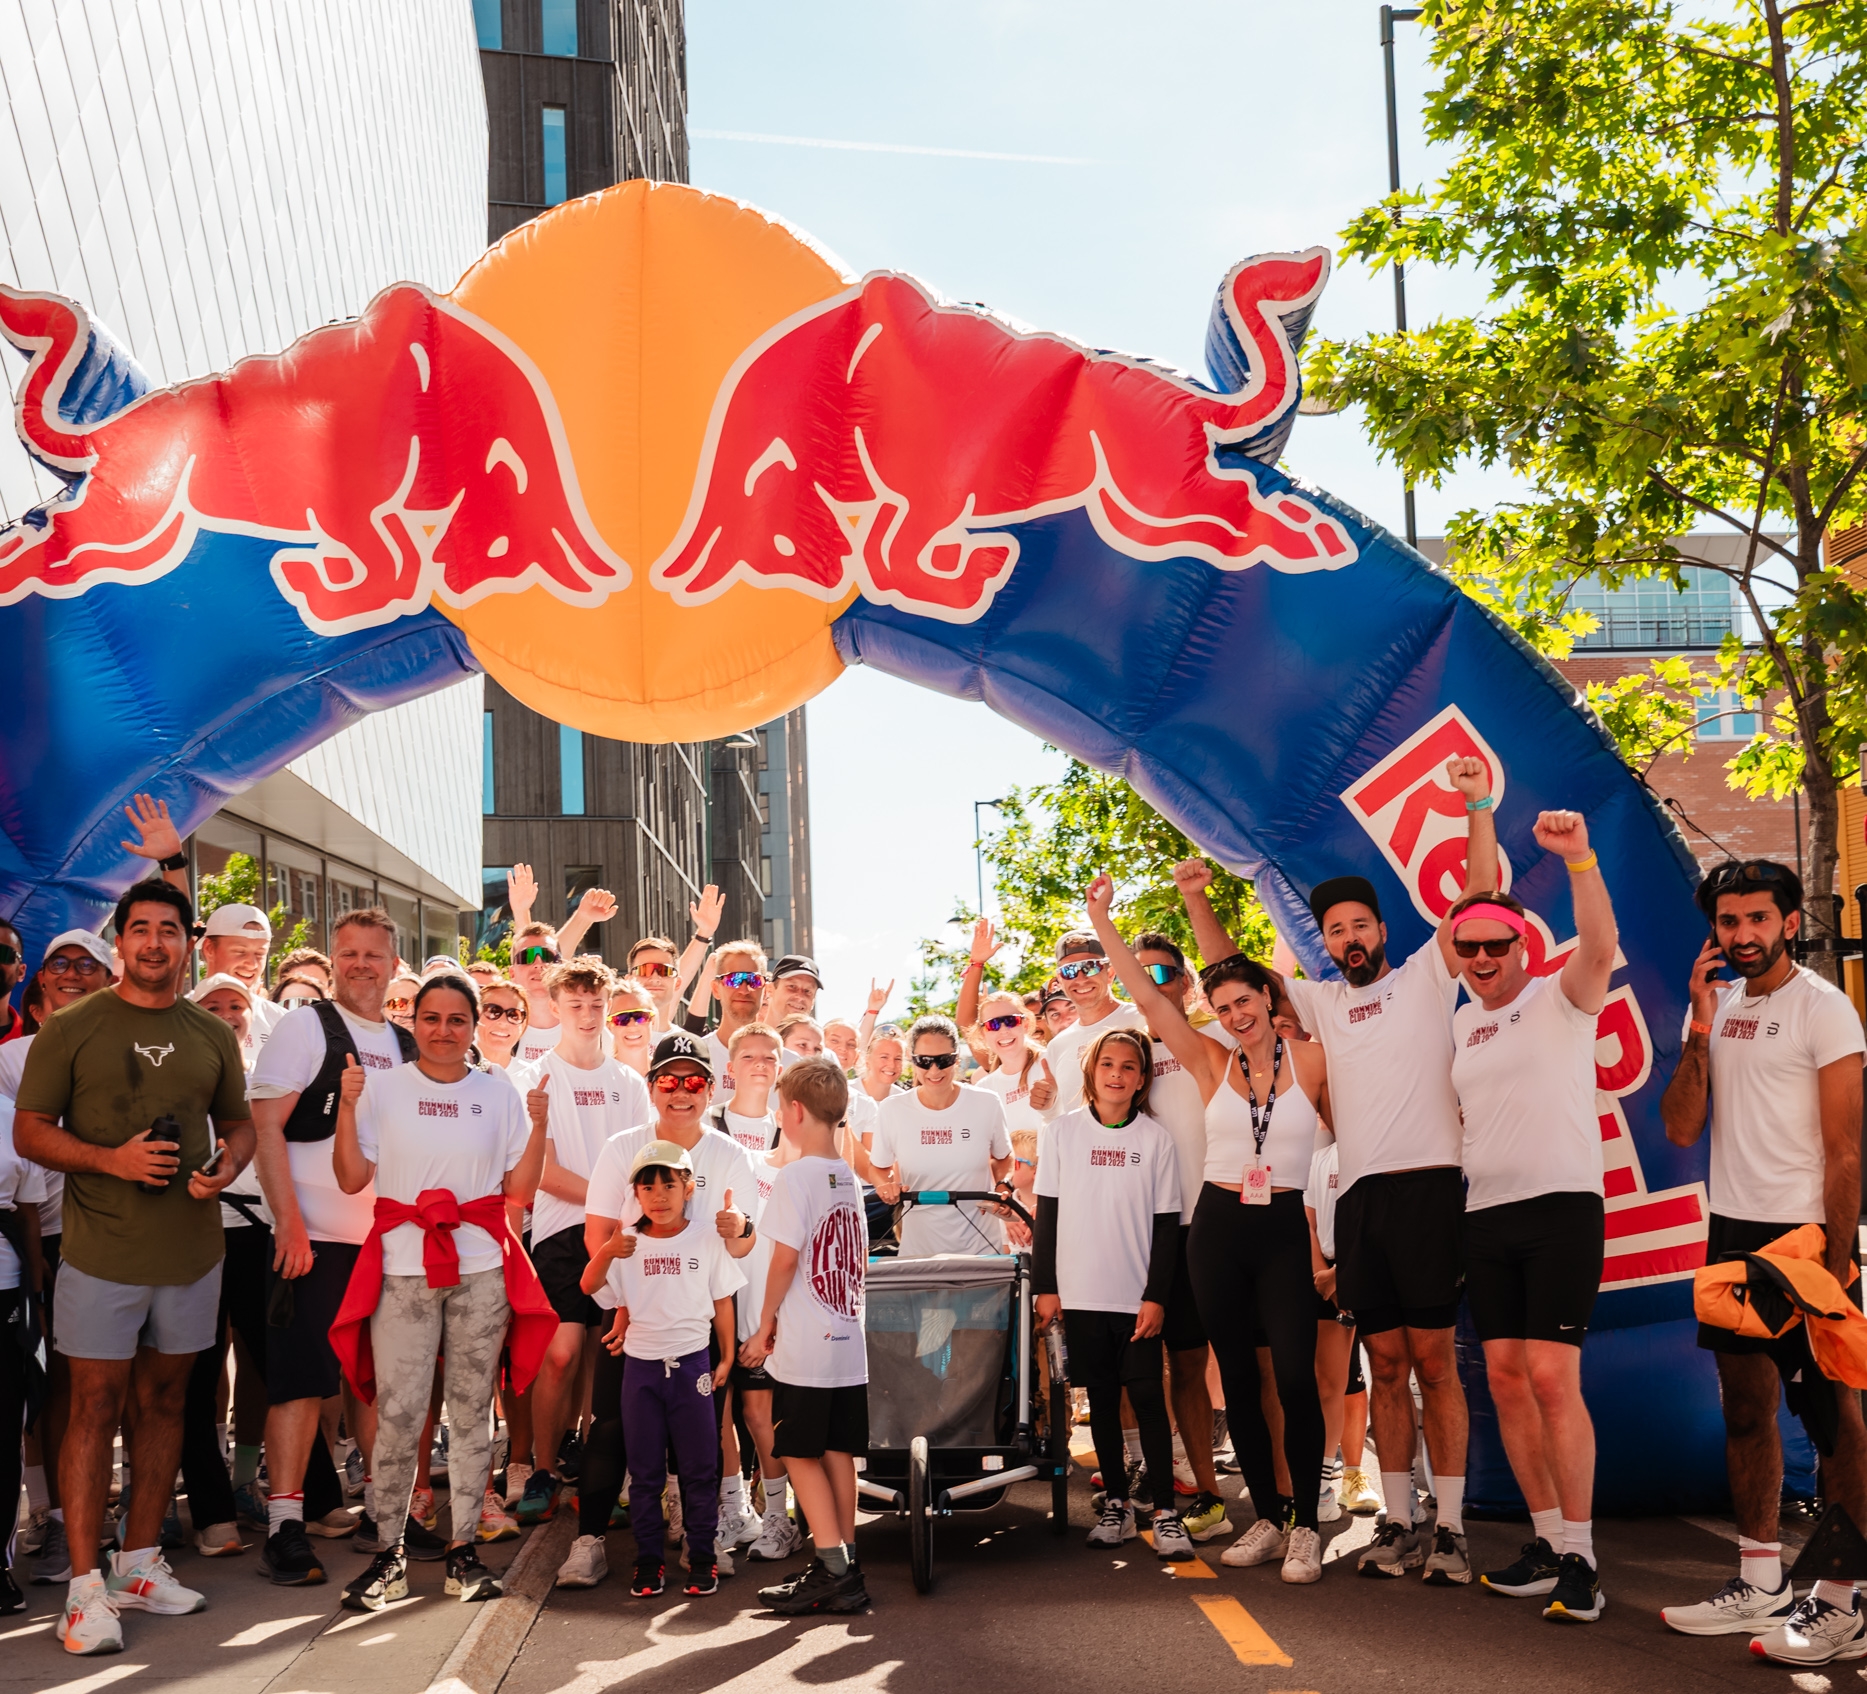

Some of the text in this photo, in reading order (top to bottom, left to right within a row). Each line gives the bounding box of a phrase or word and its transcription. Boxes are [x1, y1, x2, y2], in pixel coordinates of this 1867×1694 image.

[1350, 1013, 1366, 1024] CLUB
[1724, 1018, 1759, 1031] RUNNING
[1720, 1025, 1738, 1038] CLUB
[1737, 1029, 1756, 1040] 2025
[574, 1090, 605, 1100] RUNNING
[323, 1092, 335, 1115] SILVA
[418, 1101, 459, 1112] RUNNING
[418, 1106, 459, 1118] CLUB 2025
[921, 1129, 952, 1138] RUNNING
[921, 1136, 935, 1145] CLUB
[937, 1136, 952, 1145] 2025
[1091, 1149, 1126, 1160] RUNNING
[1091, 1155, 1125, 1167] CLUB 2025
[643, 1257, 681, 1267] RUNNING
[644, 1264, 681, 1276] CLUB 2025
